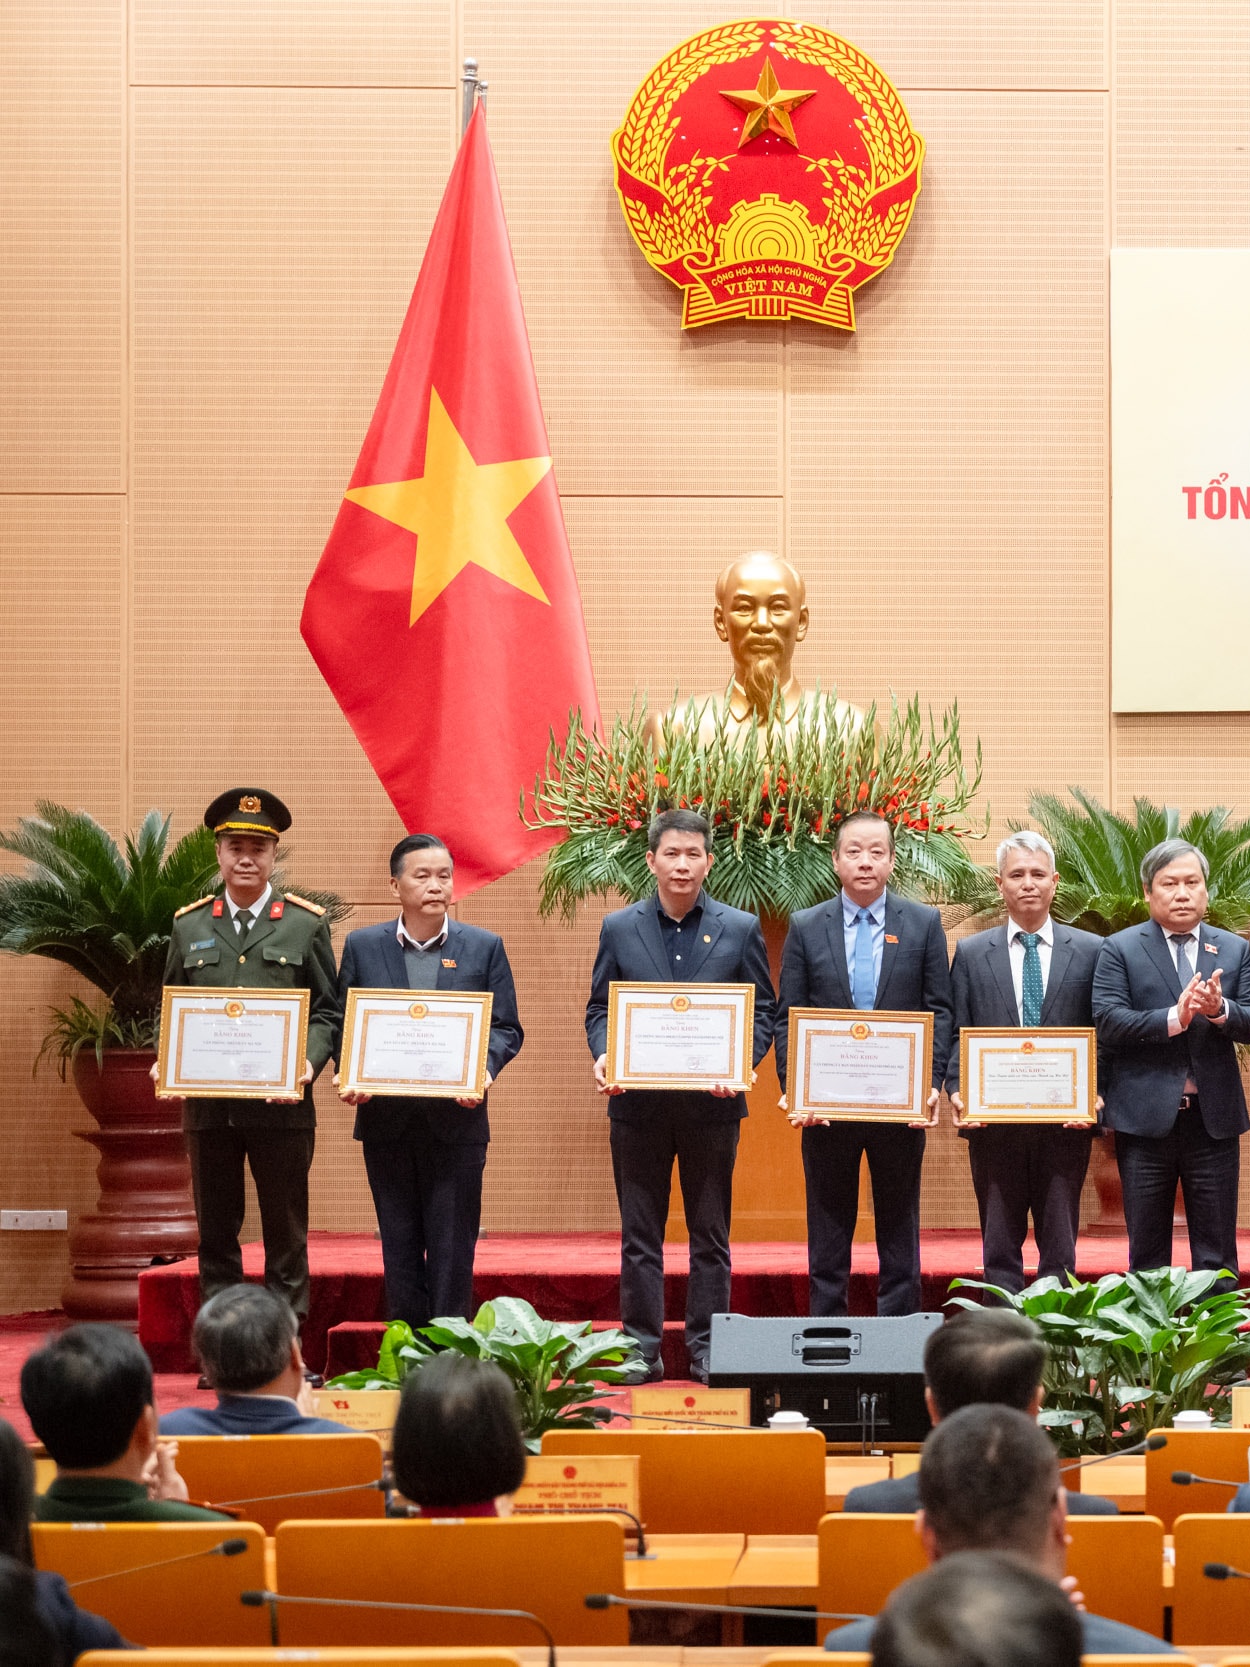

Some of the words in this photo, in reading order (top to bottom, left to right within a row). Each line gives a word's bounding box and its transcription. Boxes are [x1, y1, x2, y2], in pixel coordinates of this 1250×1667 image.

[711, 271, 735, 286] CỘNG
[735, 265, 754, 277] HÒA
[755, 264, 767, 274] XÃ
[768, 264, 783, 275] HỘI
[784, 266, 802, 277] CHỦ
[802, 271, 827, 288] NGHĨA
[724, 277, 767, 295] VIỆT
[771, 280, 814, 297] NAM
